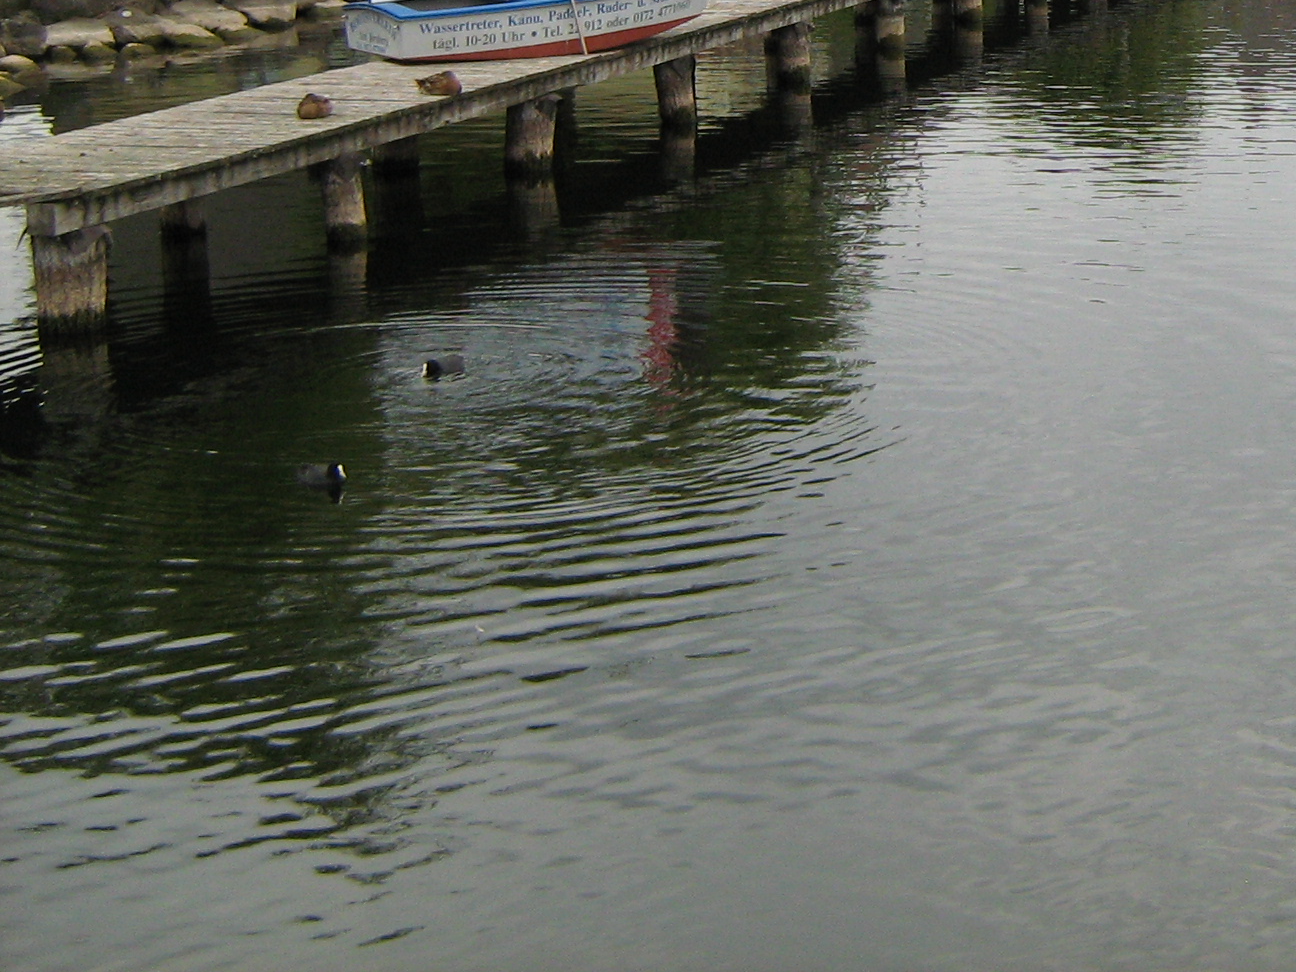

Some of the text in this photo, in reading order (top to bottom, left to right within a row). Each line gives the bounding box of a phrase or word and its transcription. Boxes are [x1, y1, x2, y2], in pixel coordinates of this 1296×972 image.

[419, 19, 503, 34] Wassertreter,
[508, 13, 543, 27] Kanu,
[433, 37, 460, 51] tägl.
[466, 34, 496, 47] 10-20
[501, 31, 525, 43] Uhr
[543, 25, 563, 38] Tel.
[584, 18, 602, 31] 912
[606, 15, 628, 28] oder
[632, 9, 654, 23] 0172
